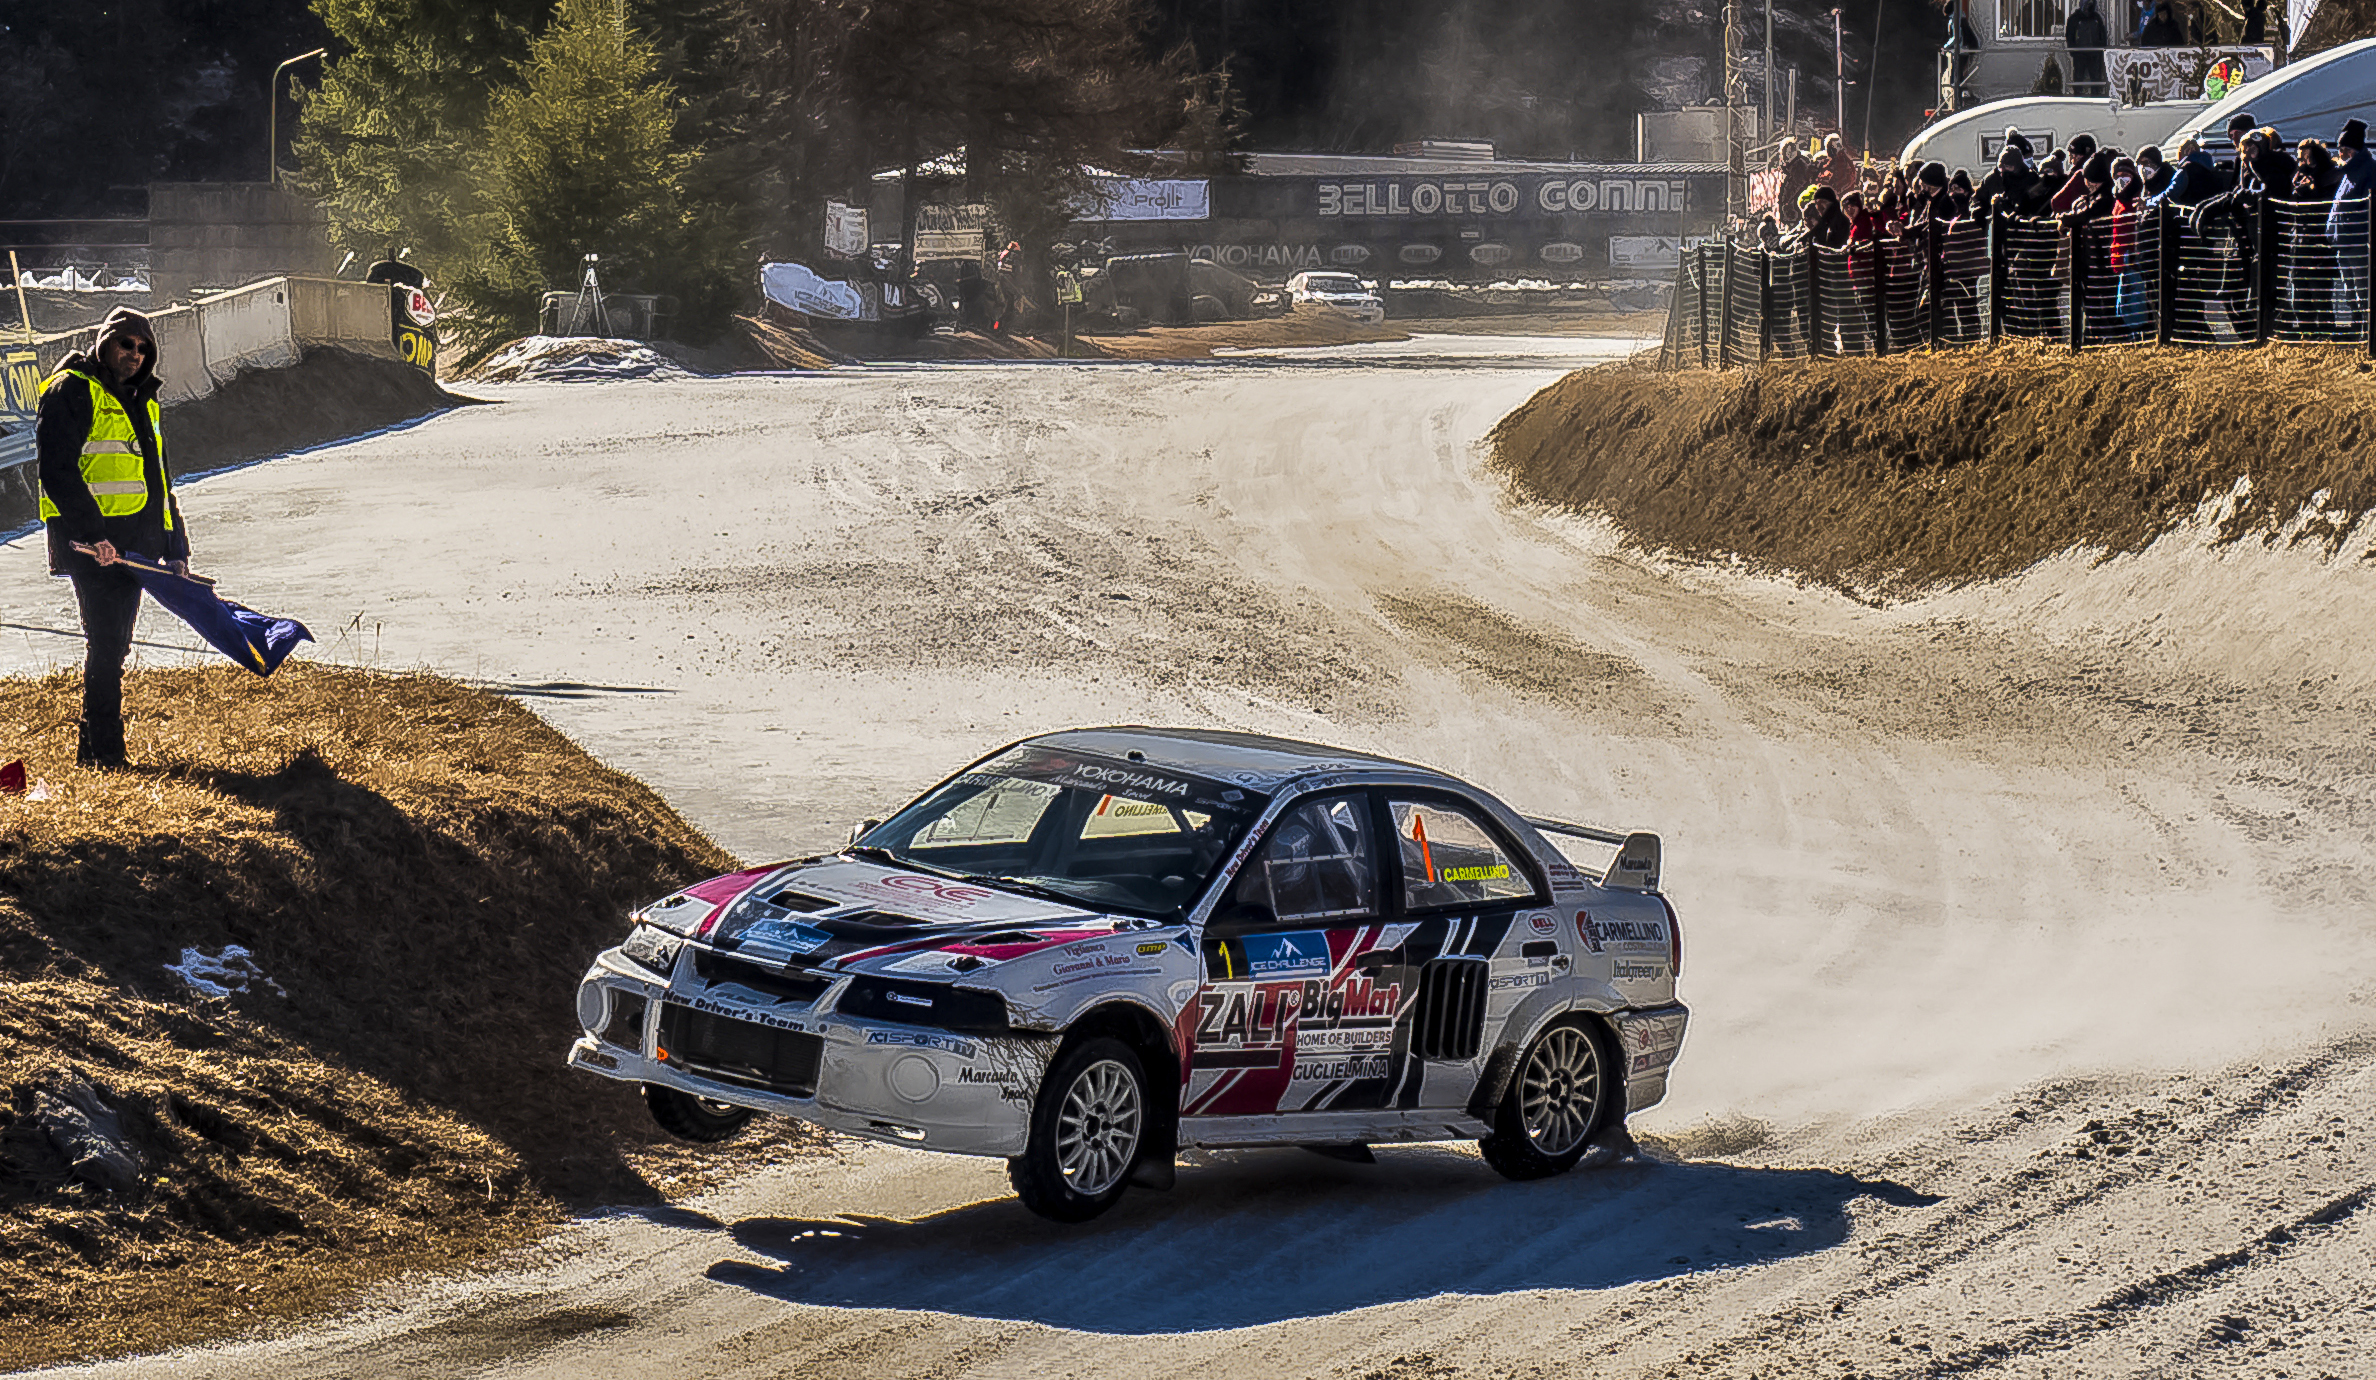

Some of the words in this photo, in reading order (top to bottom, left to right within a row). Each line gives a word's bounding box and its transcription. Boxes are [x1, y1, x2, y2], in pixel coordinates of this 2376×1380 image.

[1318, 182, 1519, 216] BELLOTTO
[1183, 244, 1323, 267] YOKOHAMA
[1074, 763, 1189, 796] YOKOHAMA
[1412, 814, 1435, 883] 1
[1443, 864, 1510, 883] CARMELLINO
[1594, 921, 1664, 942] CARMELLINO
[1218, 940, 1234, 980] 1
[662, 990, 693, 1006] New
[758, 1011, 805, 1032] Team
[1299, 976, 1400, 1029] BigMat
[1296, 1032, 1326, 1047] HOME
[1327, 1032, 1343, 1045] OF
[1343, 1030, 1392, 1045] BUILDERS
[1292, 1059, 1388, 1081] GUGLIELMINA
